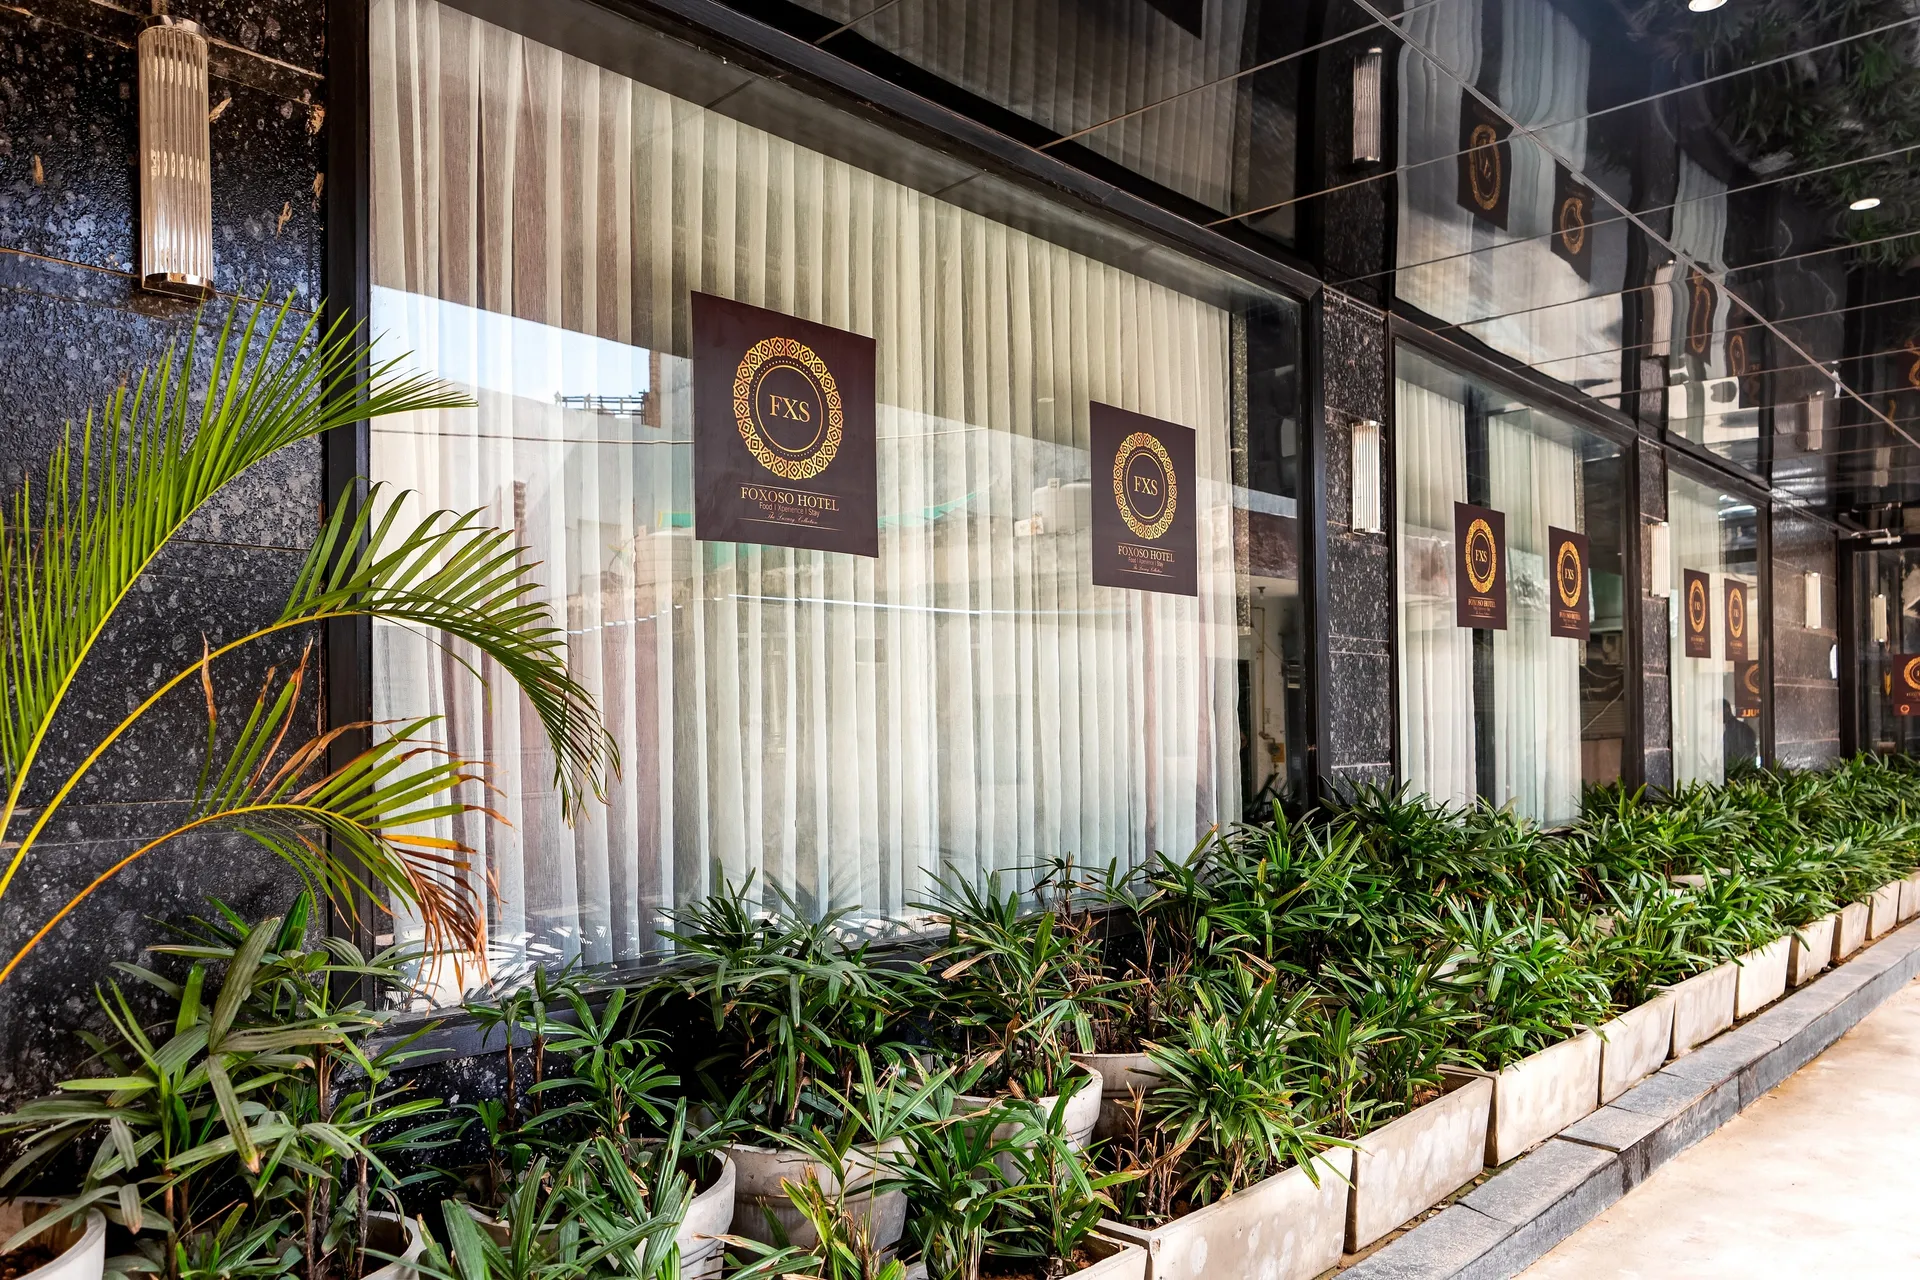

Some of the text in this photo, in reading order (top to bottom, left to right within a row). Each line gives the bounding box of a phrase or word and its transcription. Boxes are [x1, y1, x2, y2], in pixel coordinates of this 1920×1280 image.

[769, 394, 811, 423] FXS
[1133, 475, 1158, 496] FXS
[740, 486, 840, 511] FOXOSO HOTEL
[759, 502, 773, 510] Food
[809, 508, 820, 518] Stay
[1118, 545, 1175, 562] FOXOSO HOTEL
[1475, 549, 1488, 563] FXS
